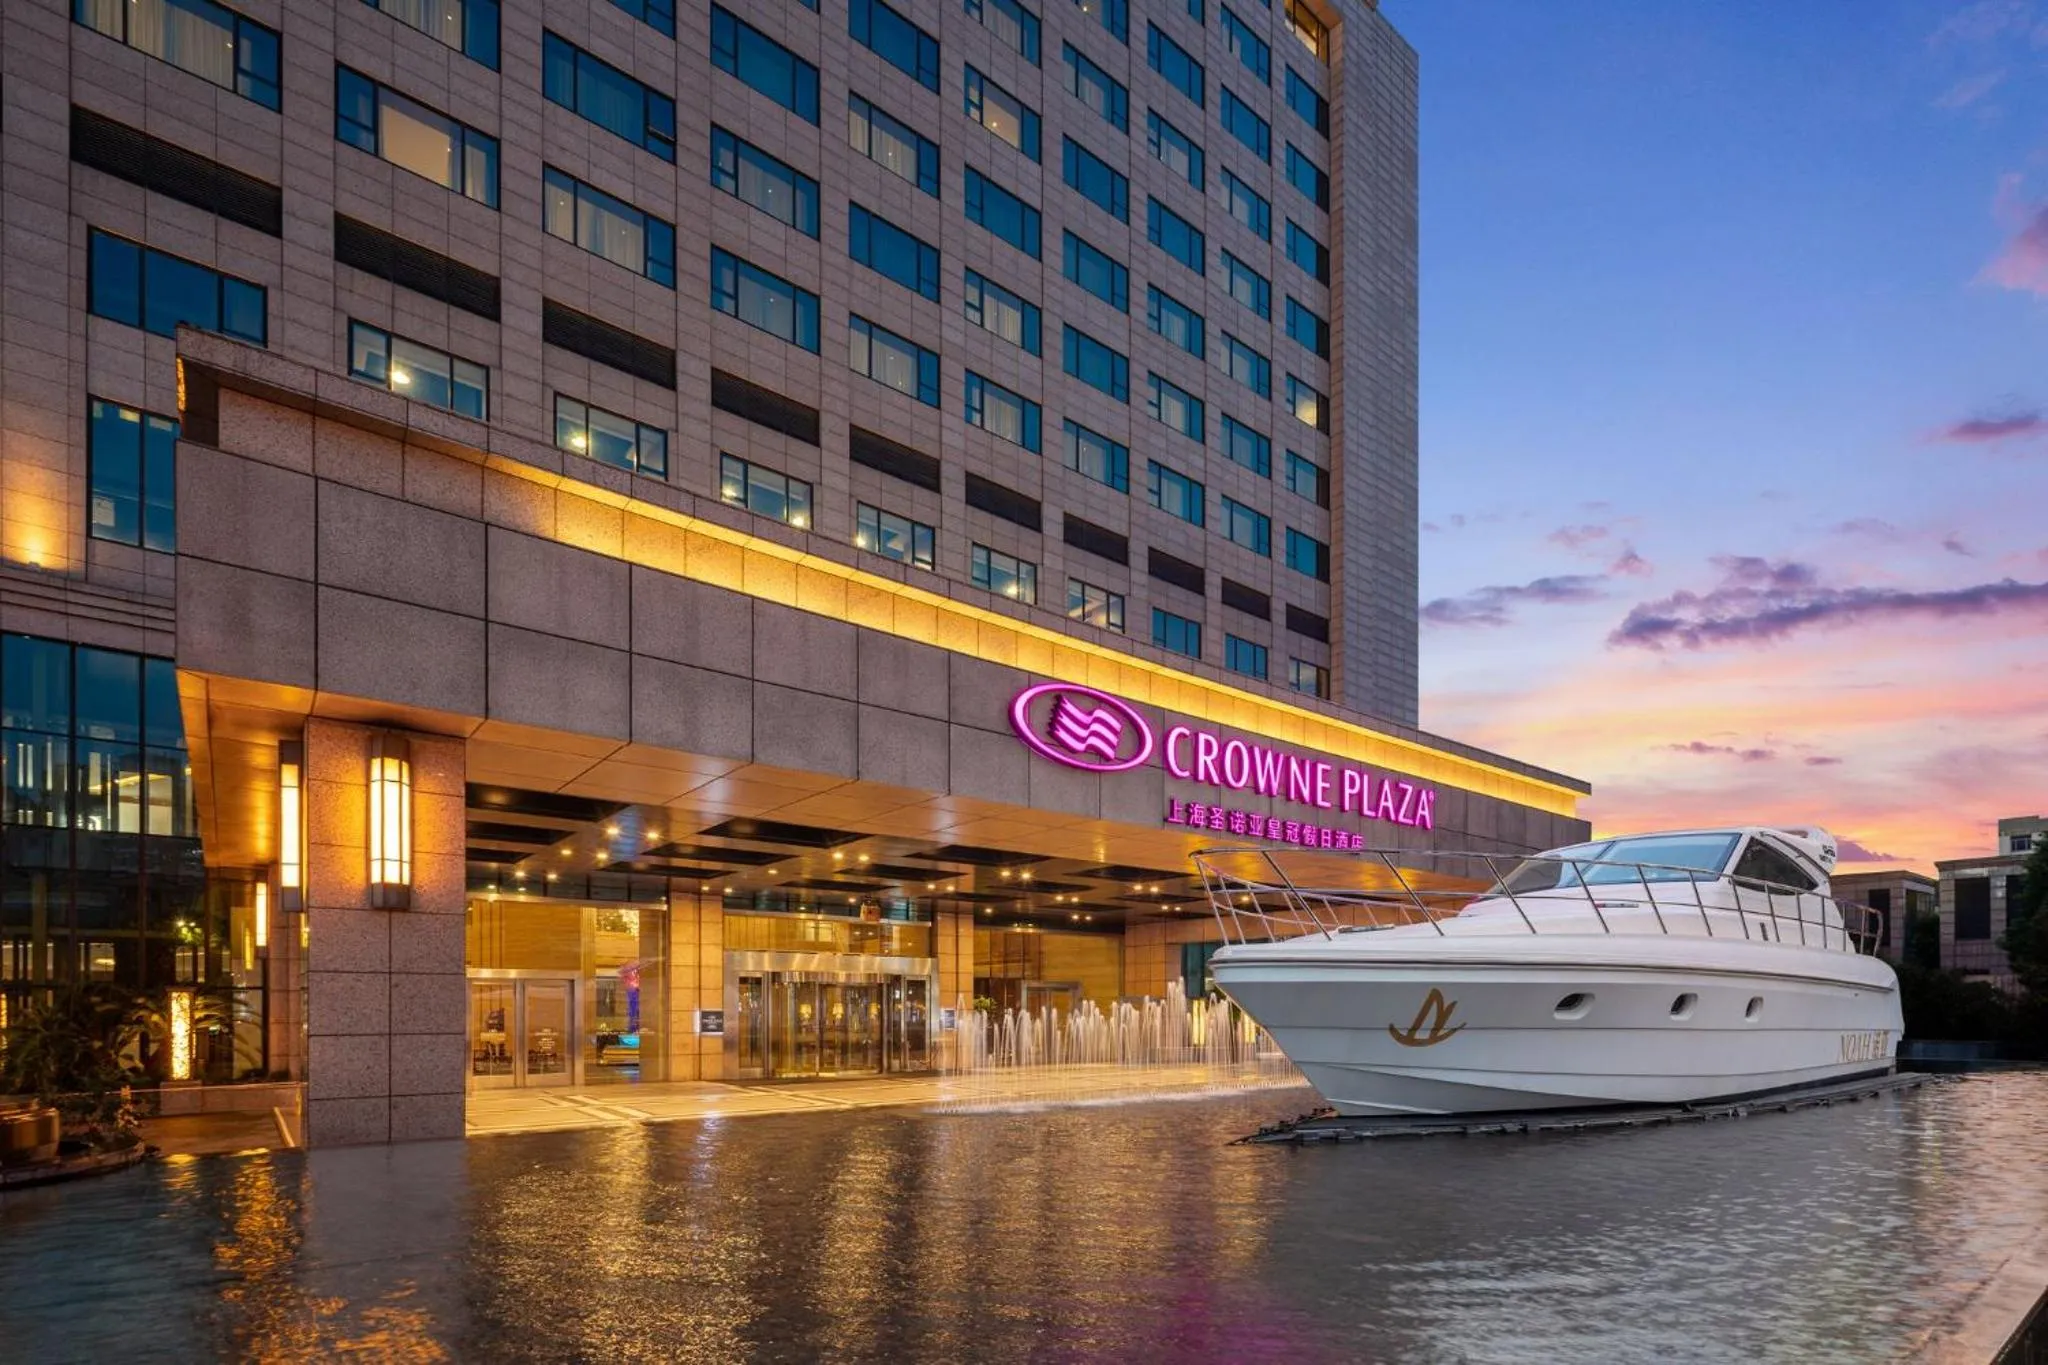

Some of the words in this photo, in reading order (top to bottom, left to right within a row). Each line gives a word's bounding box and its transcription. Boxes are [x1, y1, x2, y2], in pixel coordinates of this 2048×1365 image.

[1165, 725, 1332, 809] CROWNE
[1164, 796, 1365, 850] 上海圣诺亚皇冠假日酒店
